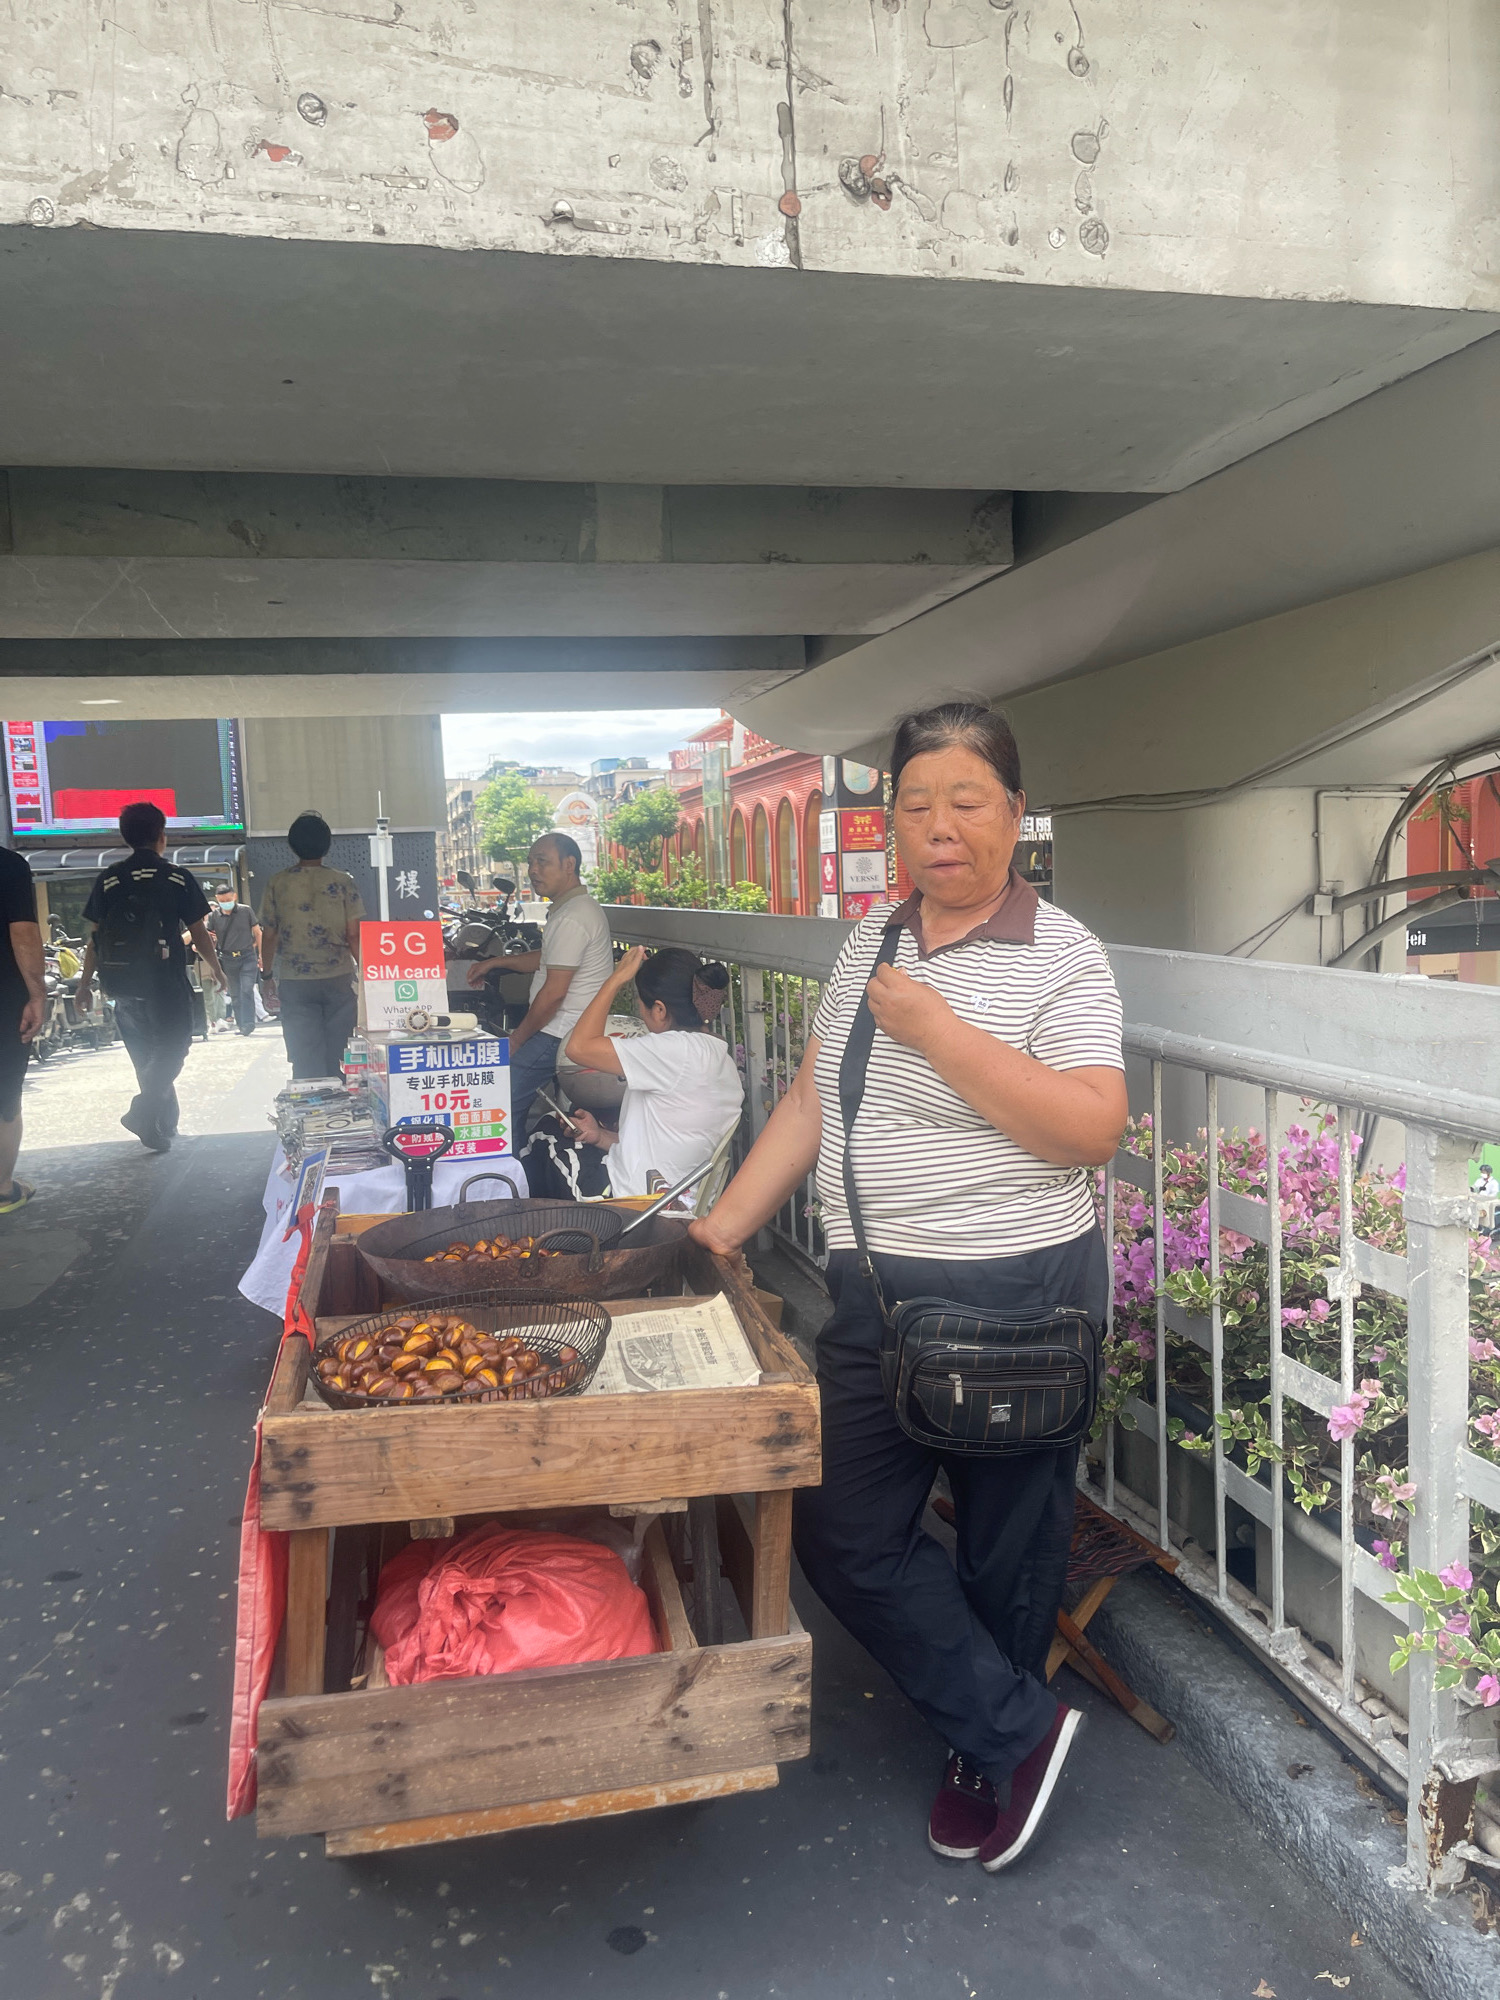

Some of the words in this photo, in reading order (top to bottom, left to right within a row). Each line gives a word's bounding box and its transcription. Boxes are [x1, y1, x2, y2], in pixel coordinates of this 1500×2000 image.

[366, 964, 400, 980] SIM
[403, 964, 441, 979] card
[399, 1041, 501, 1071] 手机贴膜
[406, 1071, 495, 1091] 专业手机贴膜
[459, 1110, 493, 1124] 曲面膜
[459, 1125, 493, 1139] 水凝膜
